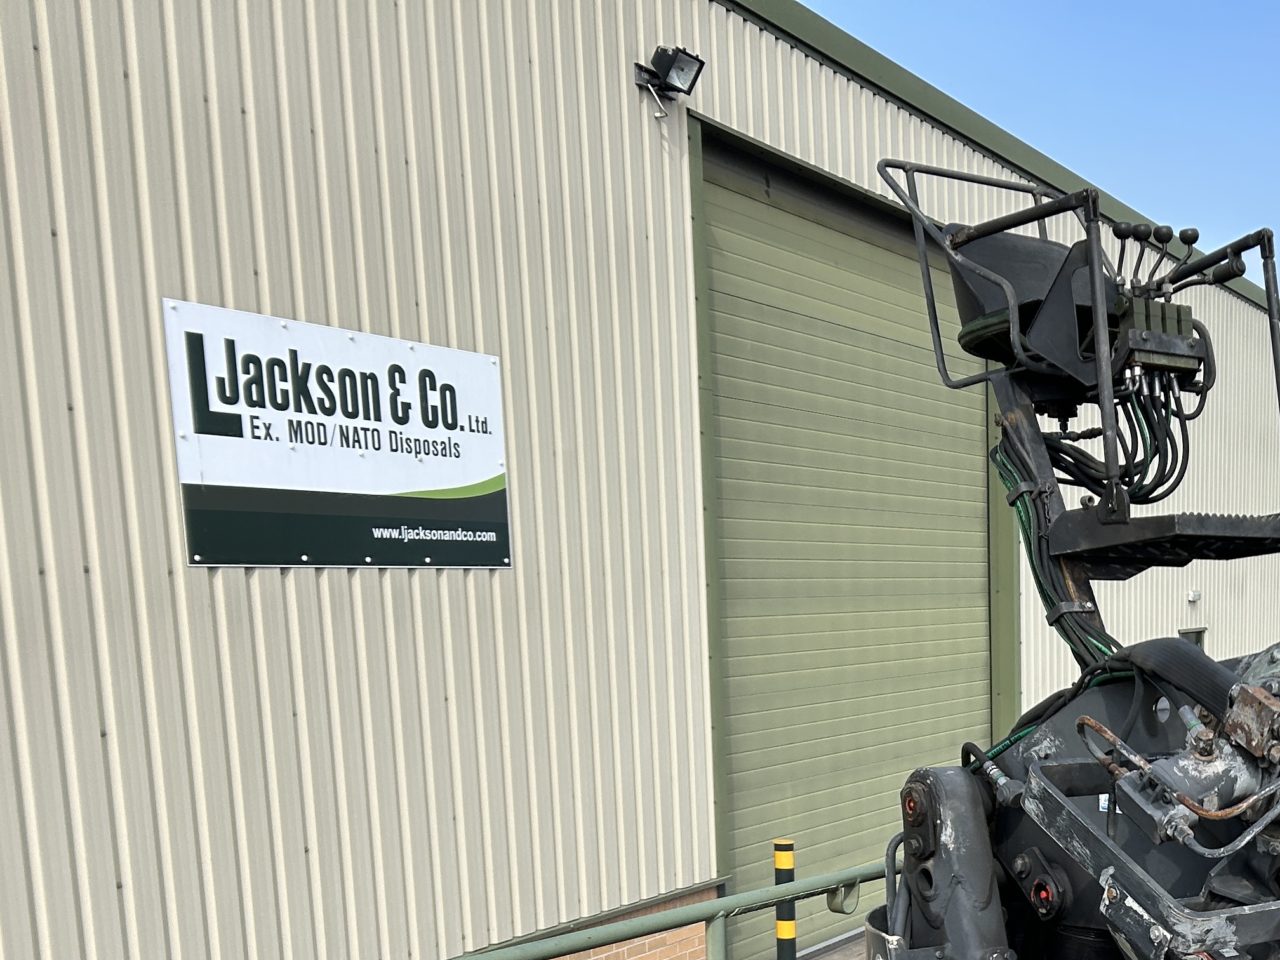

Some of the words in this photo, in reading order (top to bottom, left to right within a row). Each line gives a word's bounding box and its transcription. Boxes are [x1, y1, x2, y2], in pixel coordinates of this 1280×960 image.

[468, 414, 493, 436] Ltd.
[250, 415, 280, 442] Ex.
[288, 418, 382, 452] MOD/NATO
[389, 430, 461, 459] Disposals
[372, 525, 497, 543] www.ljacksonandco.com
